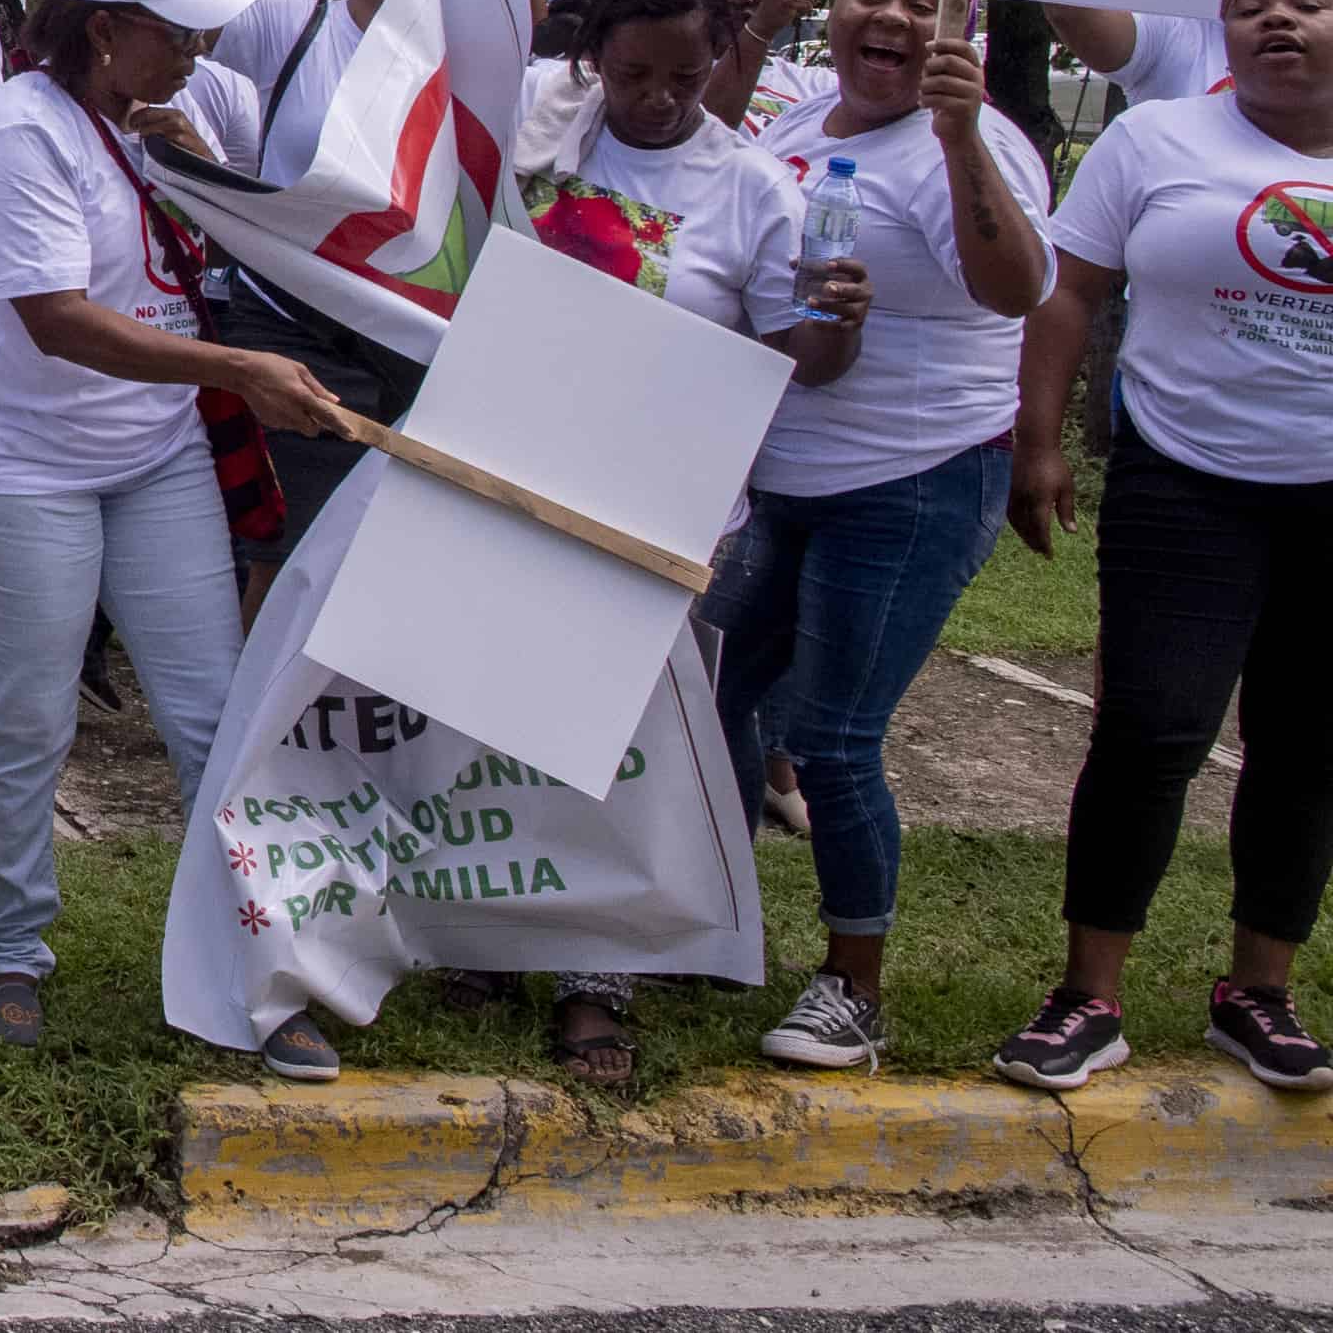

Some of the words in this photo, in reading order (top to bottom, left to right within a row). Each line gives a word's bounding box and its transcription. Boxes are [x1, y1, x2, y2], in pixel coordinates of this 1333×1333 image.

[136, 305, 156, 319] NO
[1214, 288, 1246, 301] NO
[1255, 291, 1333, 315] VERTED
[1254, 310, 1275, 321] TU
[1280, 314, 1333, 331] COMUN
[1276, 326, 1294, 337] TU
[1296, 341, 1333, 355] FAMIL
[243, 794, 318, 826] POR
[318, 781, 381, 829] TU
[389, 807, 513, 865] SUD
[281, 881, 357, 931] POR
[377, 857, 567, 916] AMILIA
